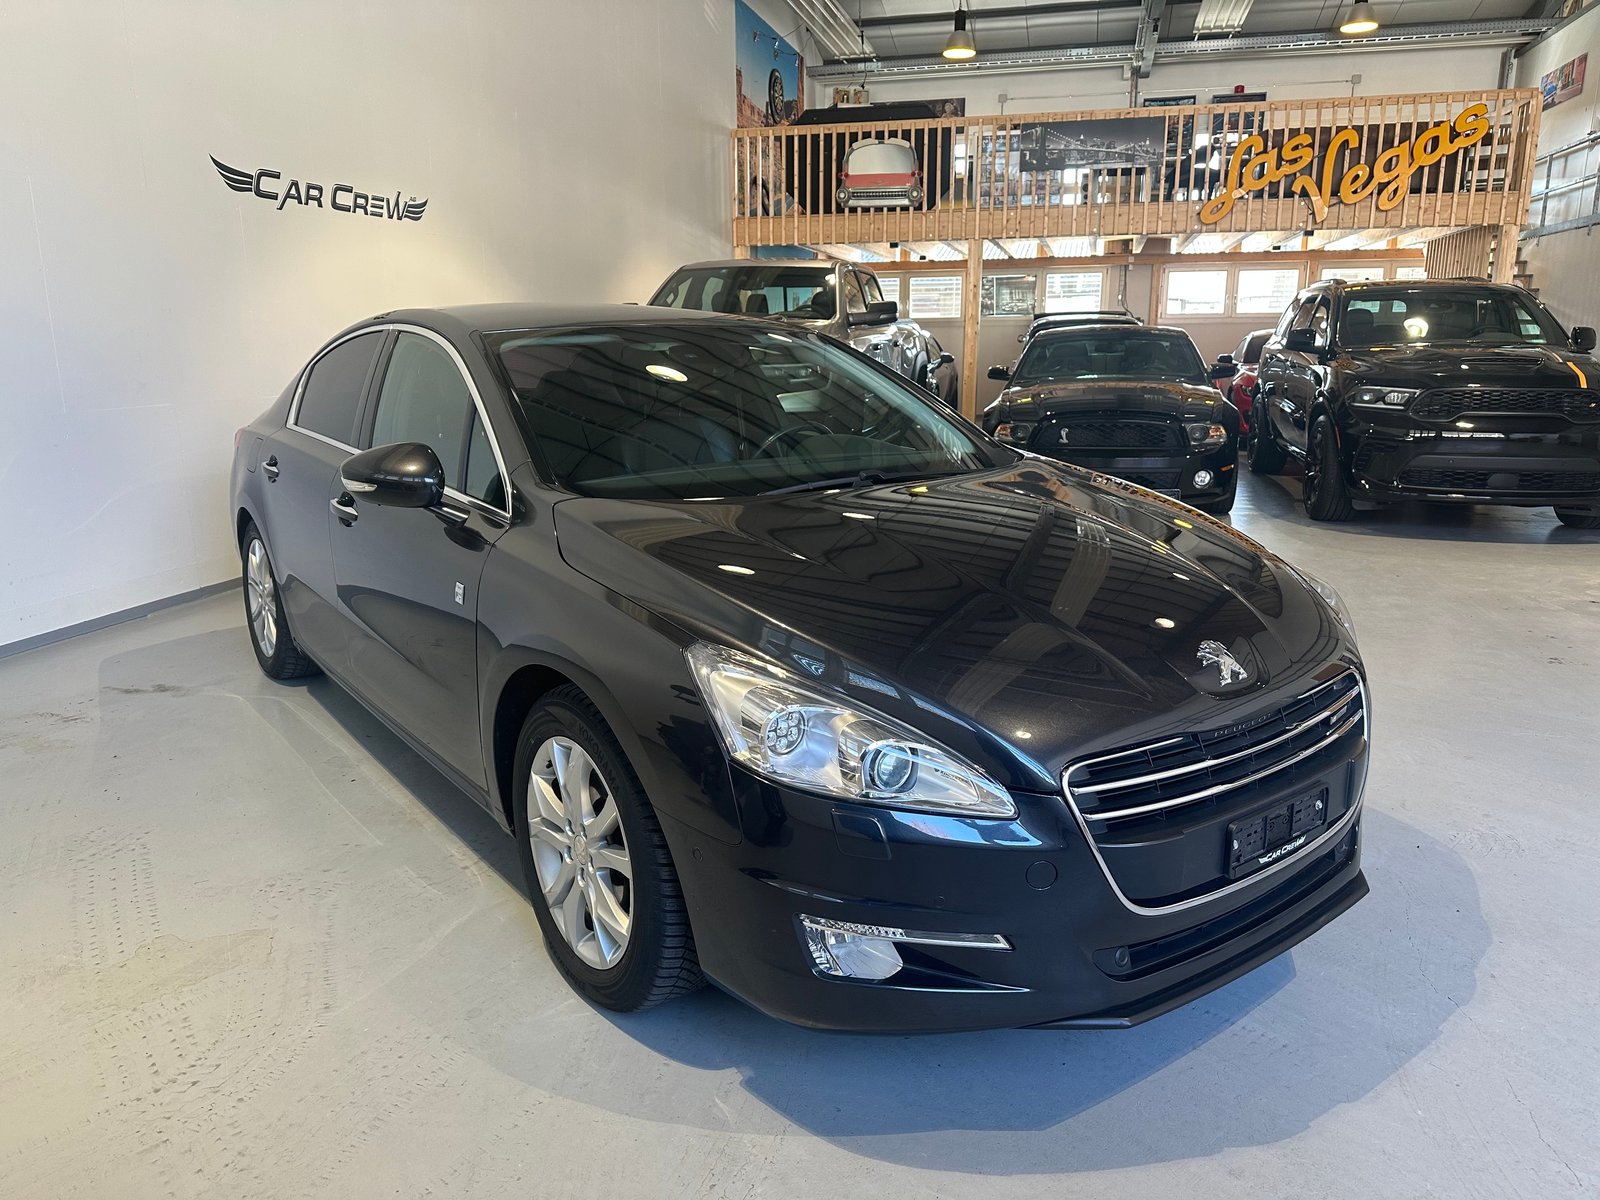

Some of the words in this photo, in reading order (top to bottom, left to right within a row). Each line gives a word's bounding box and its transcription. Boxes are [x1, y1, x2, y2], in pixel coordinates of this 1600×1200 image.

[252, 168, 324, 211] CAR
[330, 184, 408, 221] CREW
[1198, 133, 1315, 225] Las
[1291, 102, 1491, 224] Vegas
